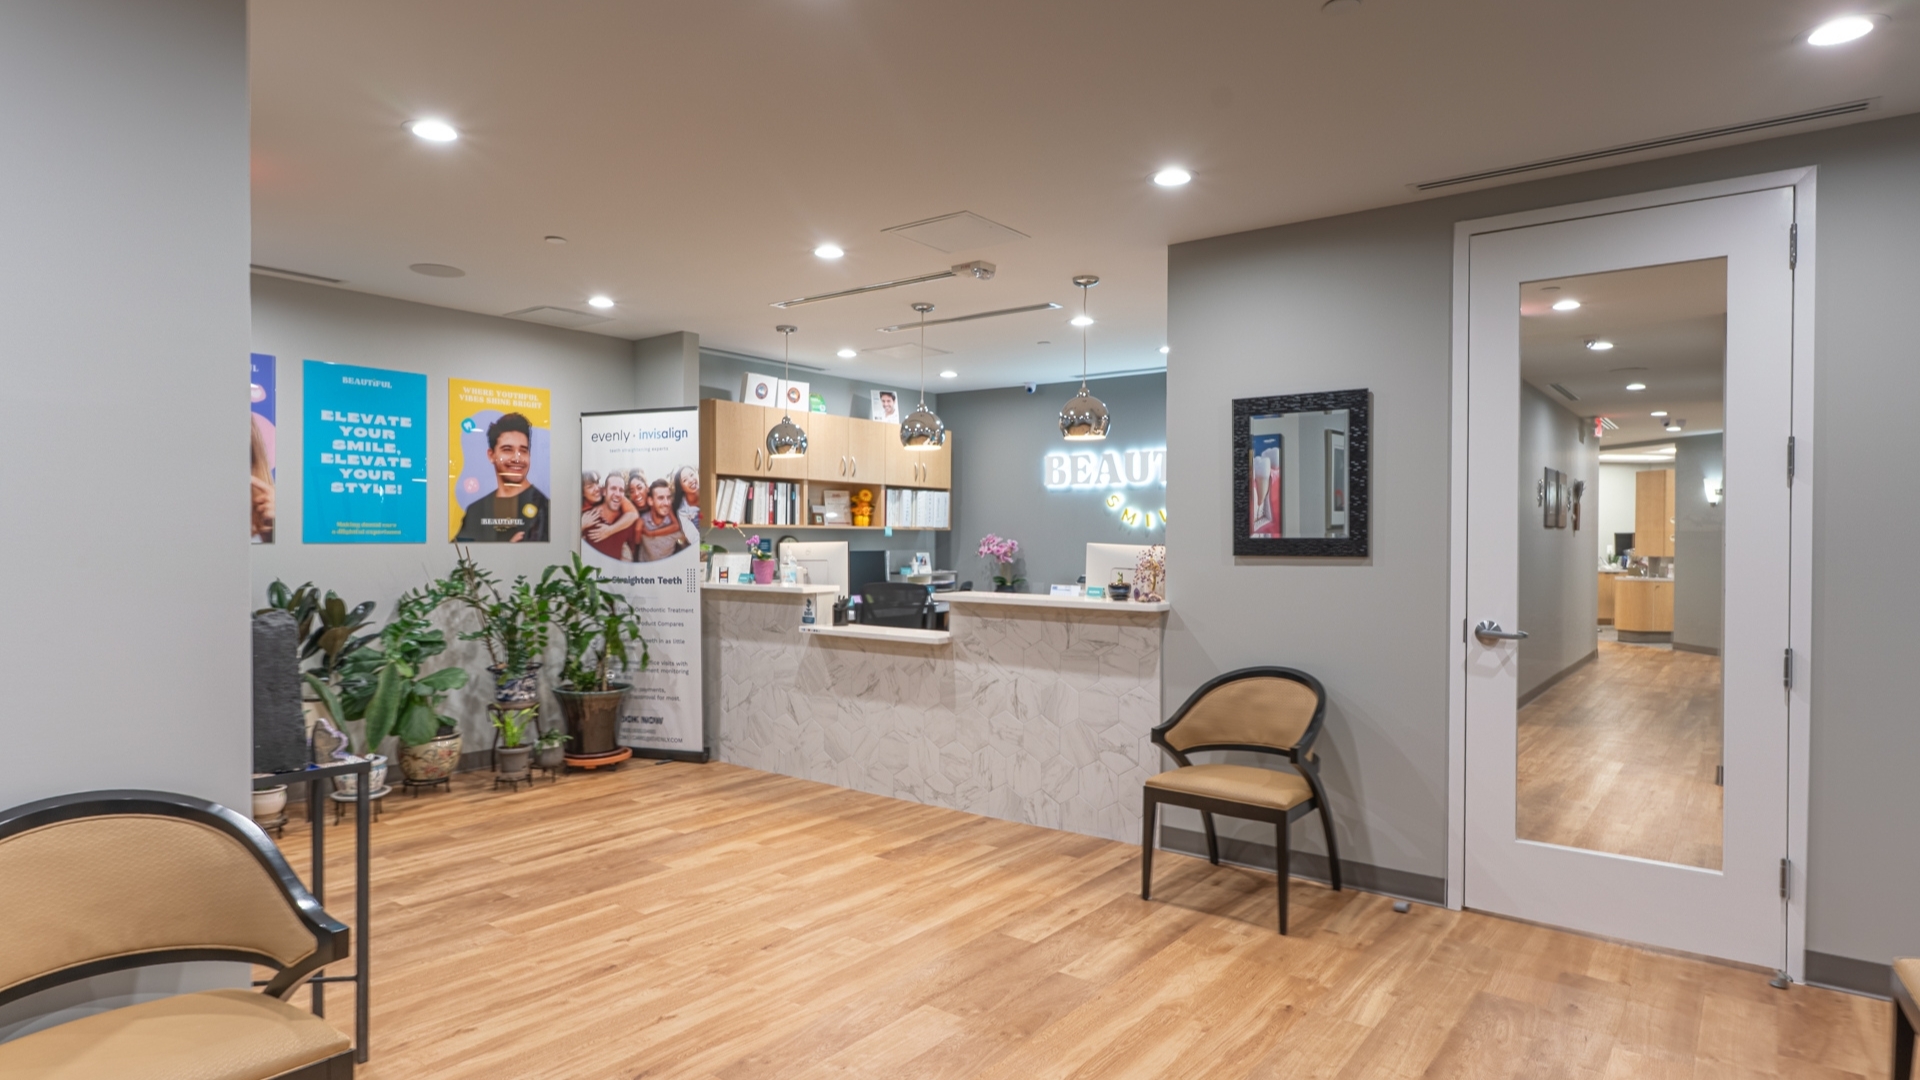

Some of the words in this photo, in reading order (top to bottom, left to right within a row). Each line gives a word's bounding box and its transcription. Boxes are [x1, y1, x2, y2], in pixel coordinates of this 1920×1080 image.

[463, 386, 494, 397] WHERE
[496, 390, 539, 402] YOUTHFUL
[459, 394, 485, 404] VIBES
[486, 396, 511, 407] SHINE
[513, 400, 542, 410] BRIGHT
[321, 409, 412, 428] ELEVATE
[339, 425, 396, 440] YOUR
[591, 429, 630, 443] evenly
[638, 427, 688, 442] invisalign
[332, 439, 401, 455] SMILE,
[321, 452, 412, 469] ELEVATE
[339, 468, 396, 480] YOUR
[331, 482, 402, 495] STYLE!
[611, 575, 655, 586] Straighten
[657, 576, 682, 585] Teeth
[634, 606, 666, 614] Orthodontic
[667, 606, 694, 614] Treatment
[657, 620, 684, 628] Compares
[661, 660, 675, 668] visits
[660, 668, 689, 676] monitoring
[621, 715, 639, 724] OOK
[641, 716, 664, 725] NOW
